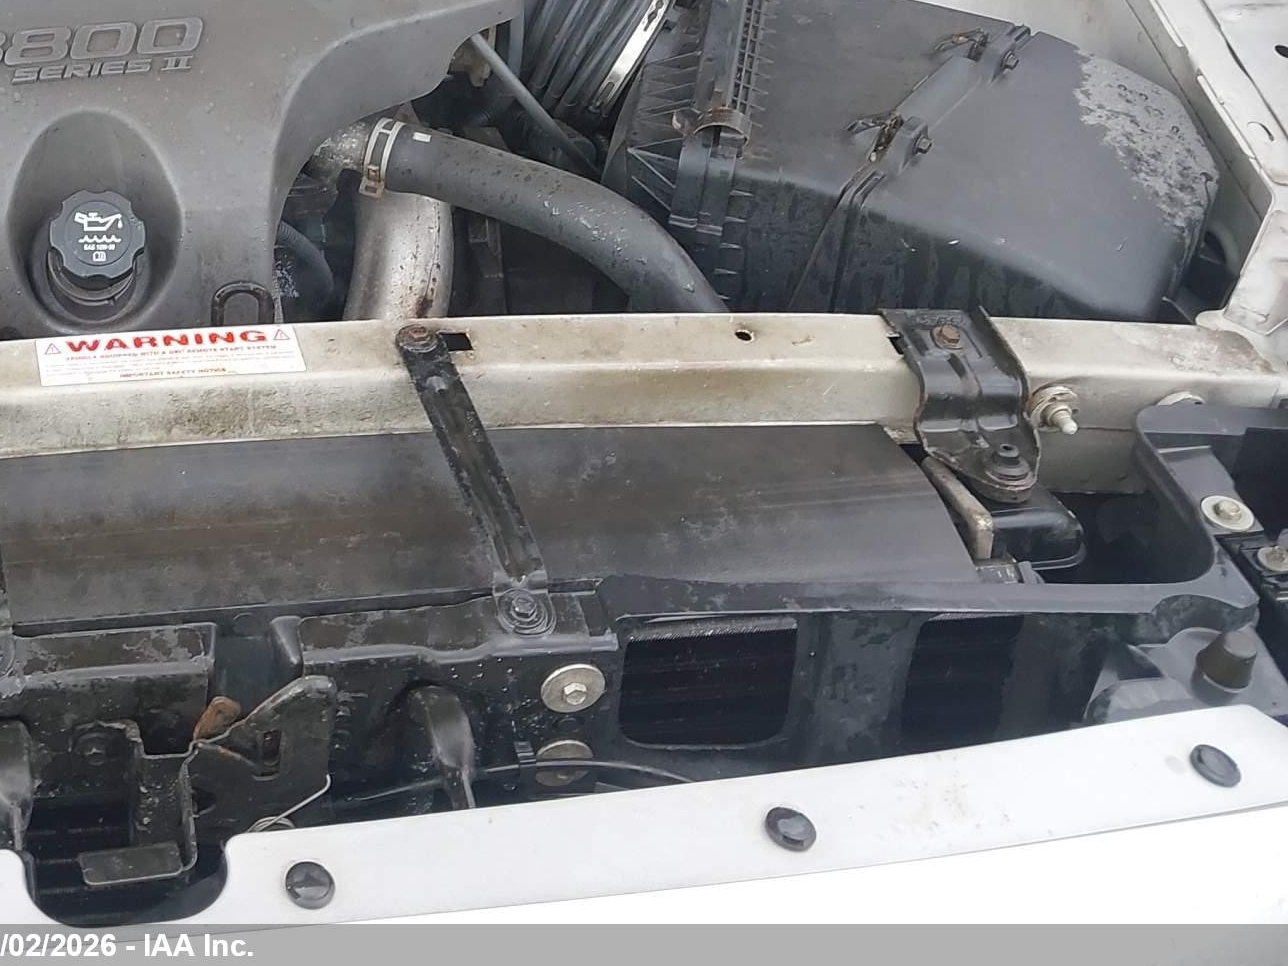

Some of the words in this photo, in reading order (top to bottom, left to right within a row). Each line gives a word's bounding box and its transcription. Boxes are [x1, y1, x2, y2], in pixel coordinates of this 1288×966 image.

[11, 58, 152, 85] SERIES
[160, 55, 195, 71] II
[65, 330, 267, 353] WARNING
